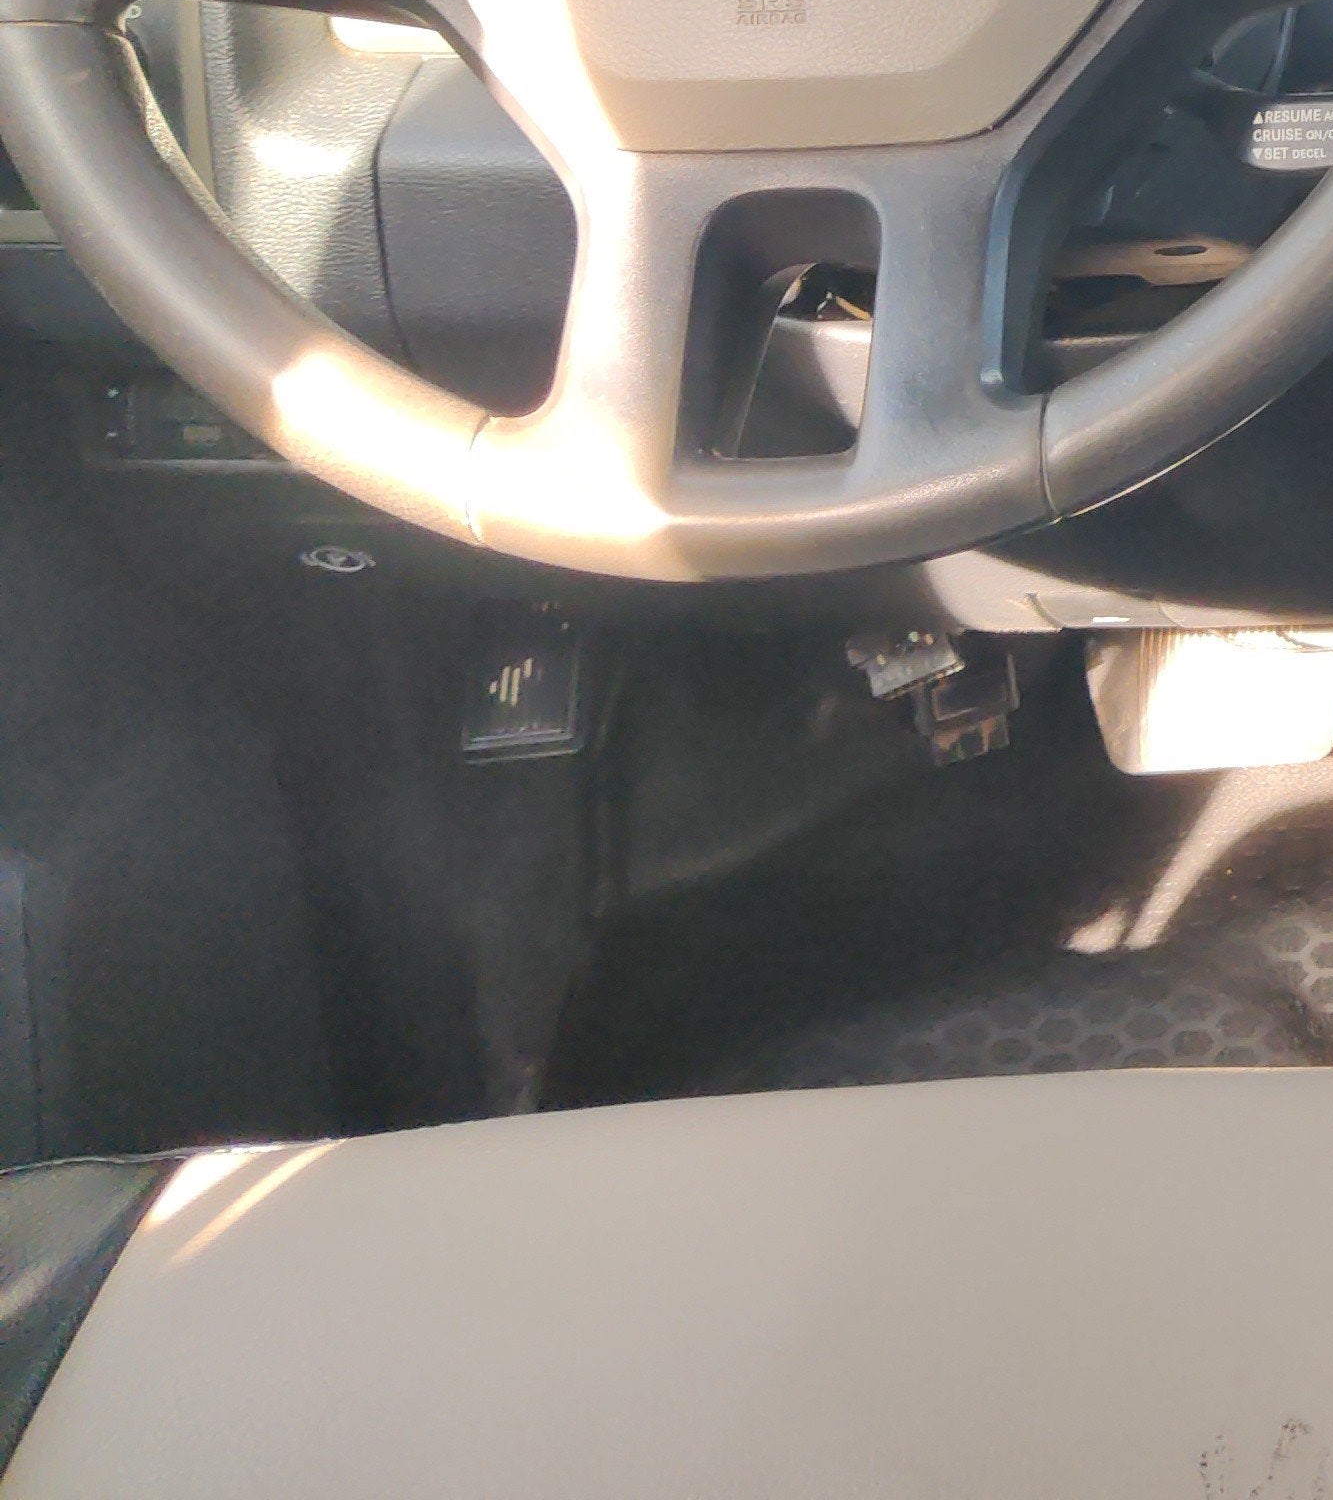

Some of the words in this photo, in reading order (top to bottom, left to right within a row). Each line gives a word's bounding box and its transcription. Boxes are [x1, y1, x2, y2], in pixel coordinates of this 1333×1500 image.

[1264, 108, 1323, 123] RESUME
[1252, 128, 1303, 142] CRUISE
[1264, 147, 1290, 161] SET
[1291, 149, 1327, 160] DECEL
